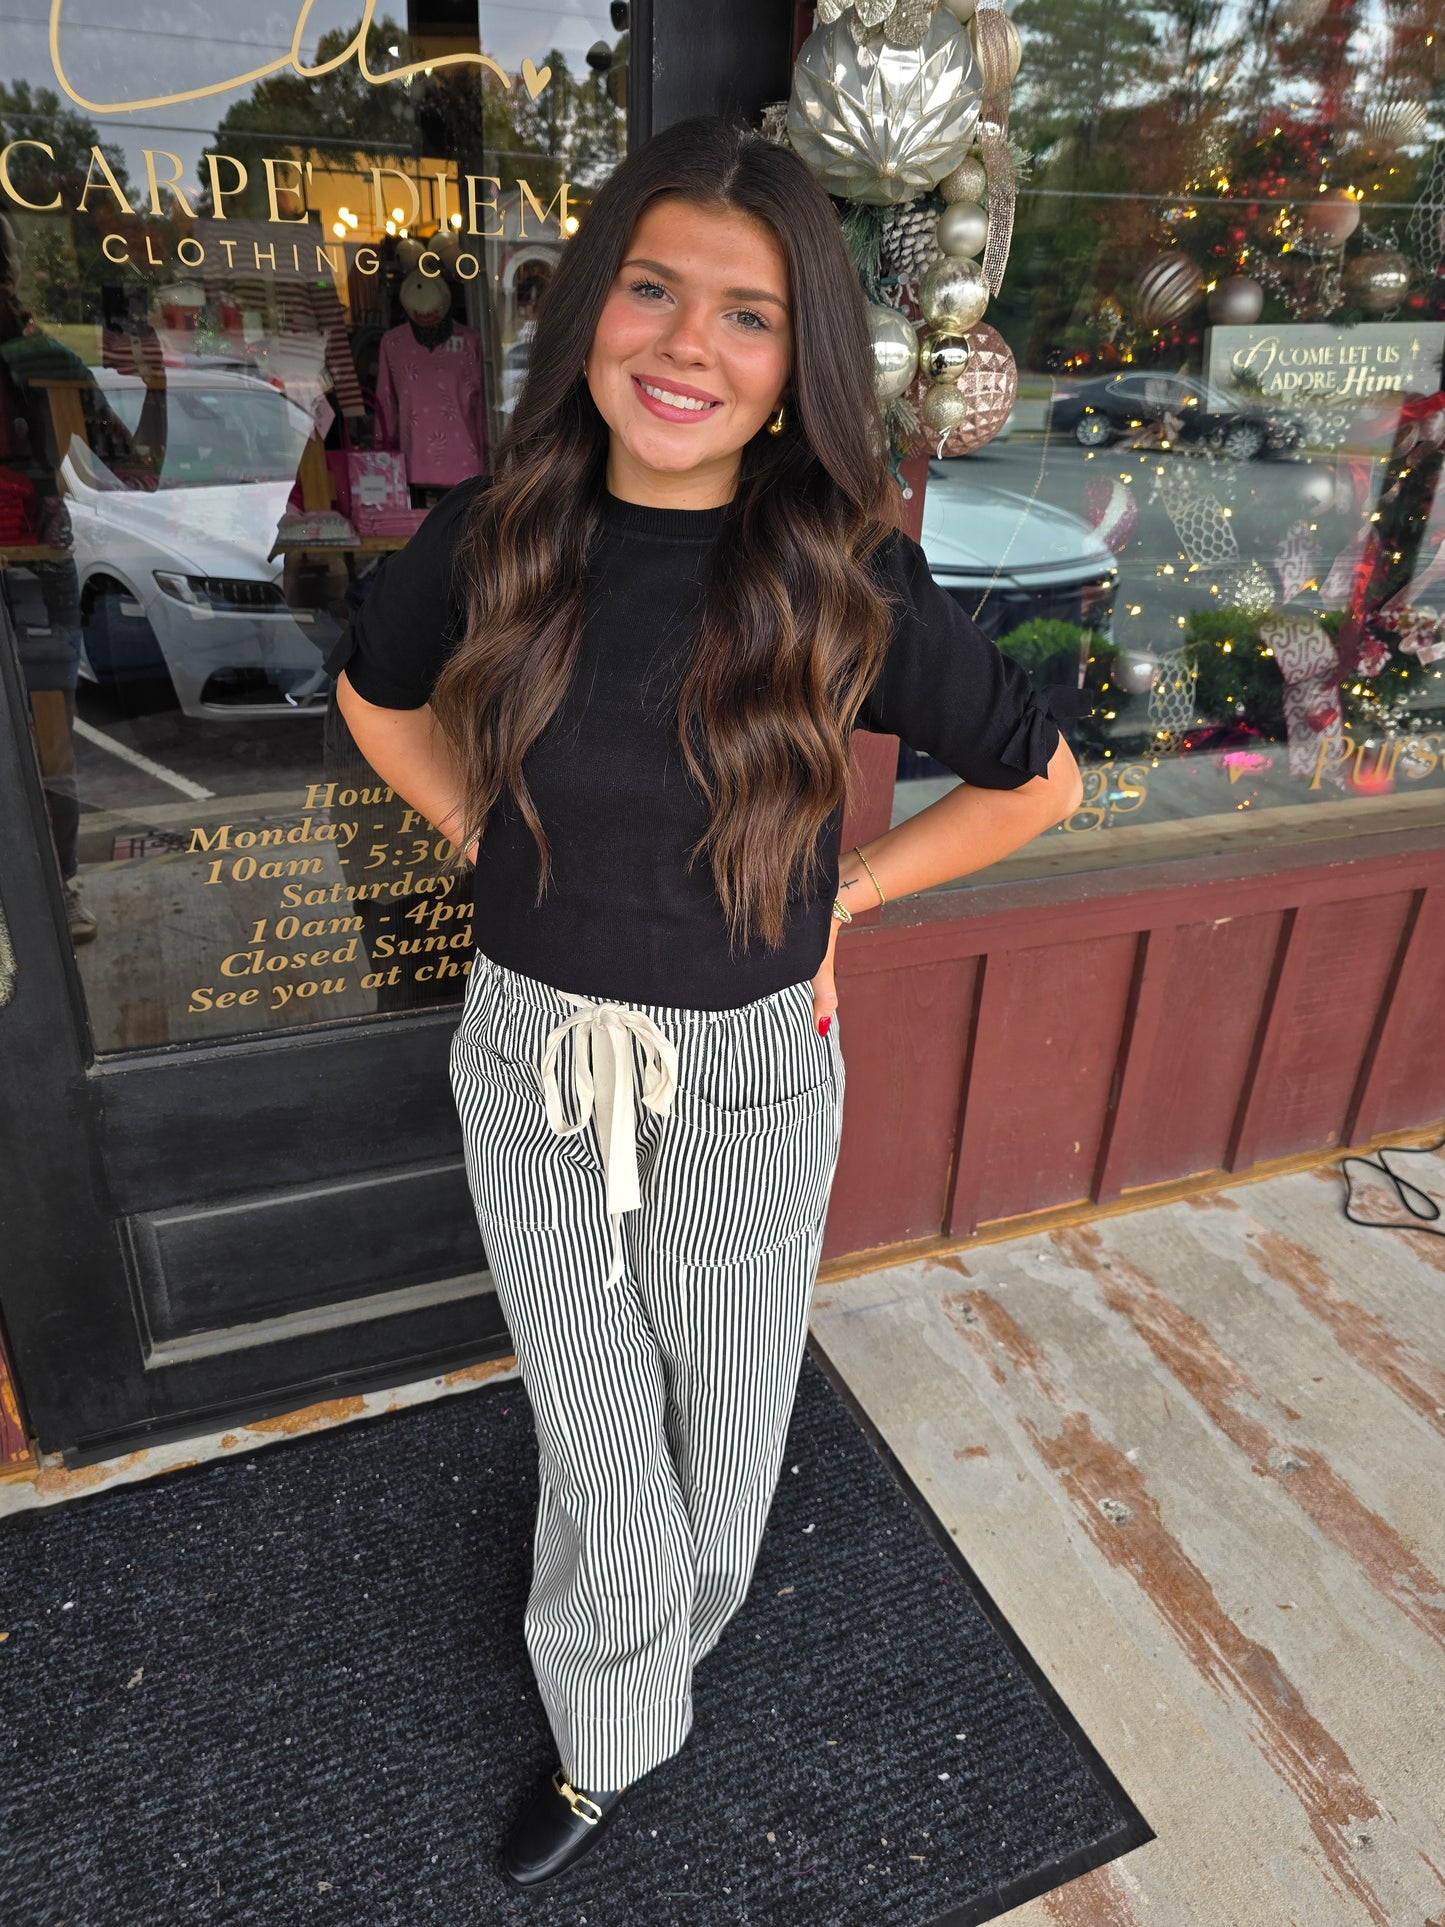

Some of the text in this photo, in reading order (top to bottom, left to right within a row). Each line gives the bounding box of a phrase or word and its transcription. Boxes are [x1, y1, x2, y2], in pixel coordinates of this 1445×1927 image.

[370, 167, 571, 240] DIEM
[102, 234, 380, 276] CLOTHING
[1278, 345, 1335, 367] COME
[1339, 345, 1372, 365] LET
[1376, 345, 1400, 364] US
[1270, 365, 1403, 397] ADORE Him
[1308, 733, 1445, 791] Purs
[301, 782, 395, 810] Hour
[185, 817, 360, 854] Monday
[203, 855, 325, 885] 10am
[363, 837, 467, 870] 5:30
[279, 872, 455, 910] Saturday
[247, 912, 366, 944] 10am
[220, 925, 474, 978] Closed Sund
[187, 987, 260, 1013] See
[270, 977, 347, 1010] you
[359, 964, 403, 989] at
